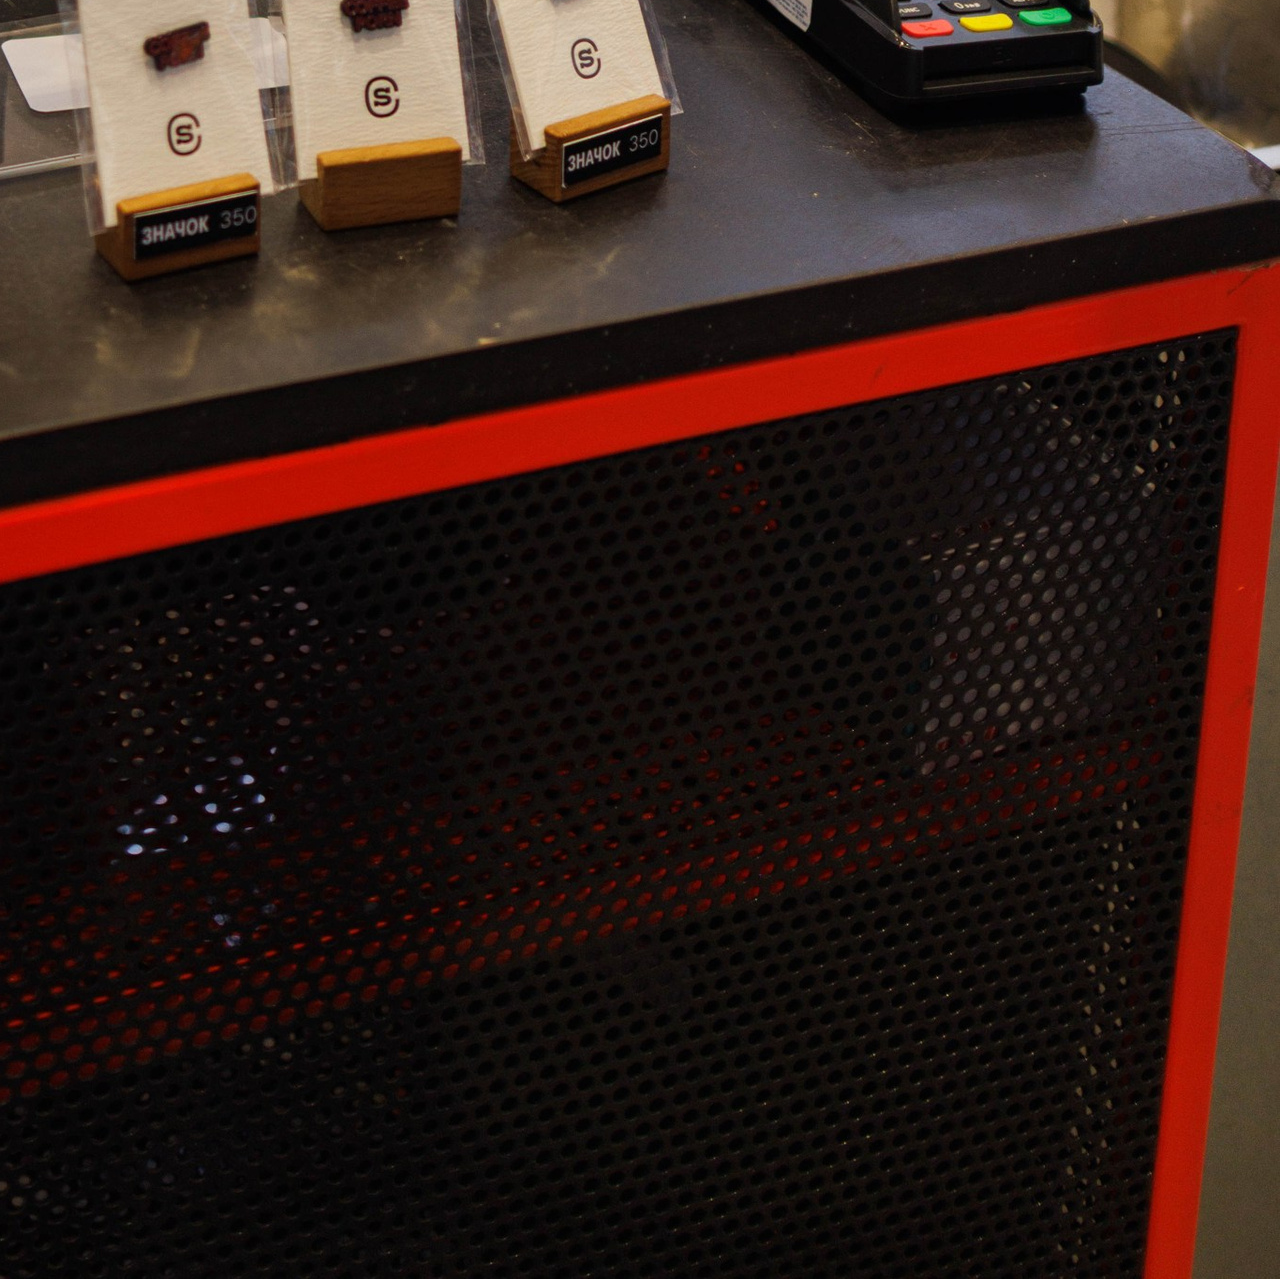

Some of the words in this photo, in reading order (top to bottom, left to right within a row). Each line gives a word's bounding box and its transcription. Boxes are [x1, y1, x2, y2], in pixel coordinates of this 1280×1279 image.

[567, 140, 621, 172] ЗНАЧОК
[628, 128, 659, 152] 350
[141, 214, 210, 245] ЗНАЧОК
[220, 205, 257, 229] 350
